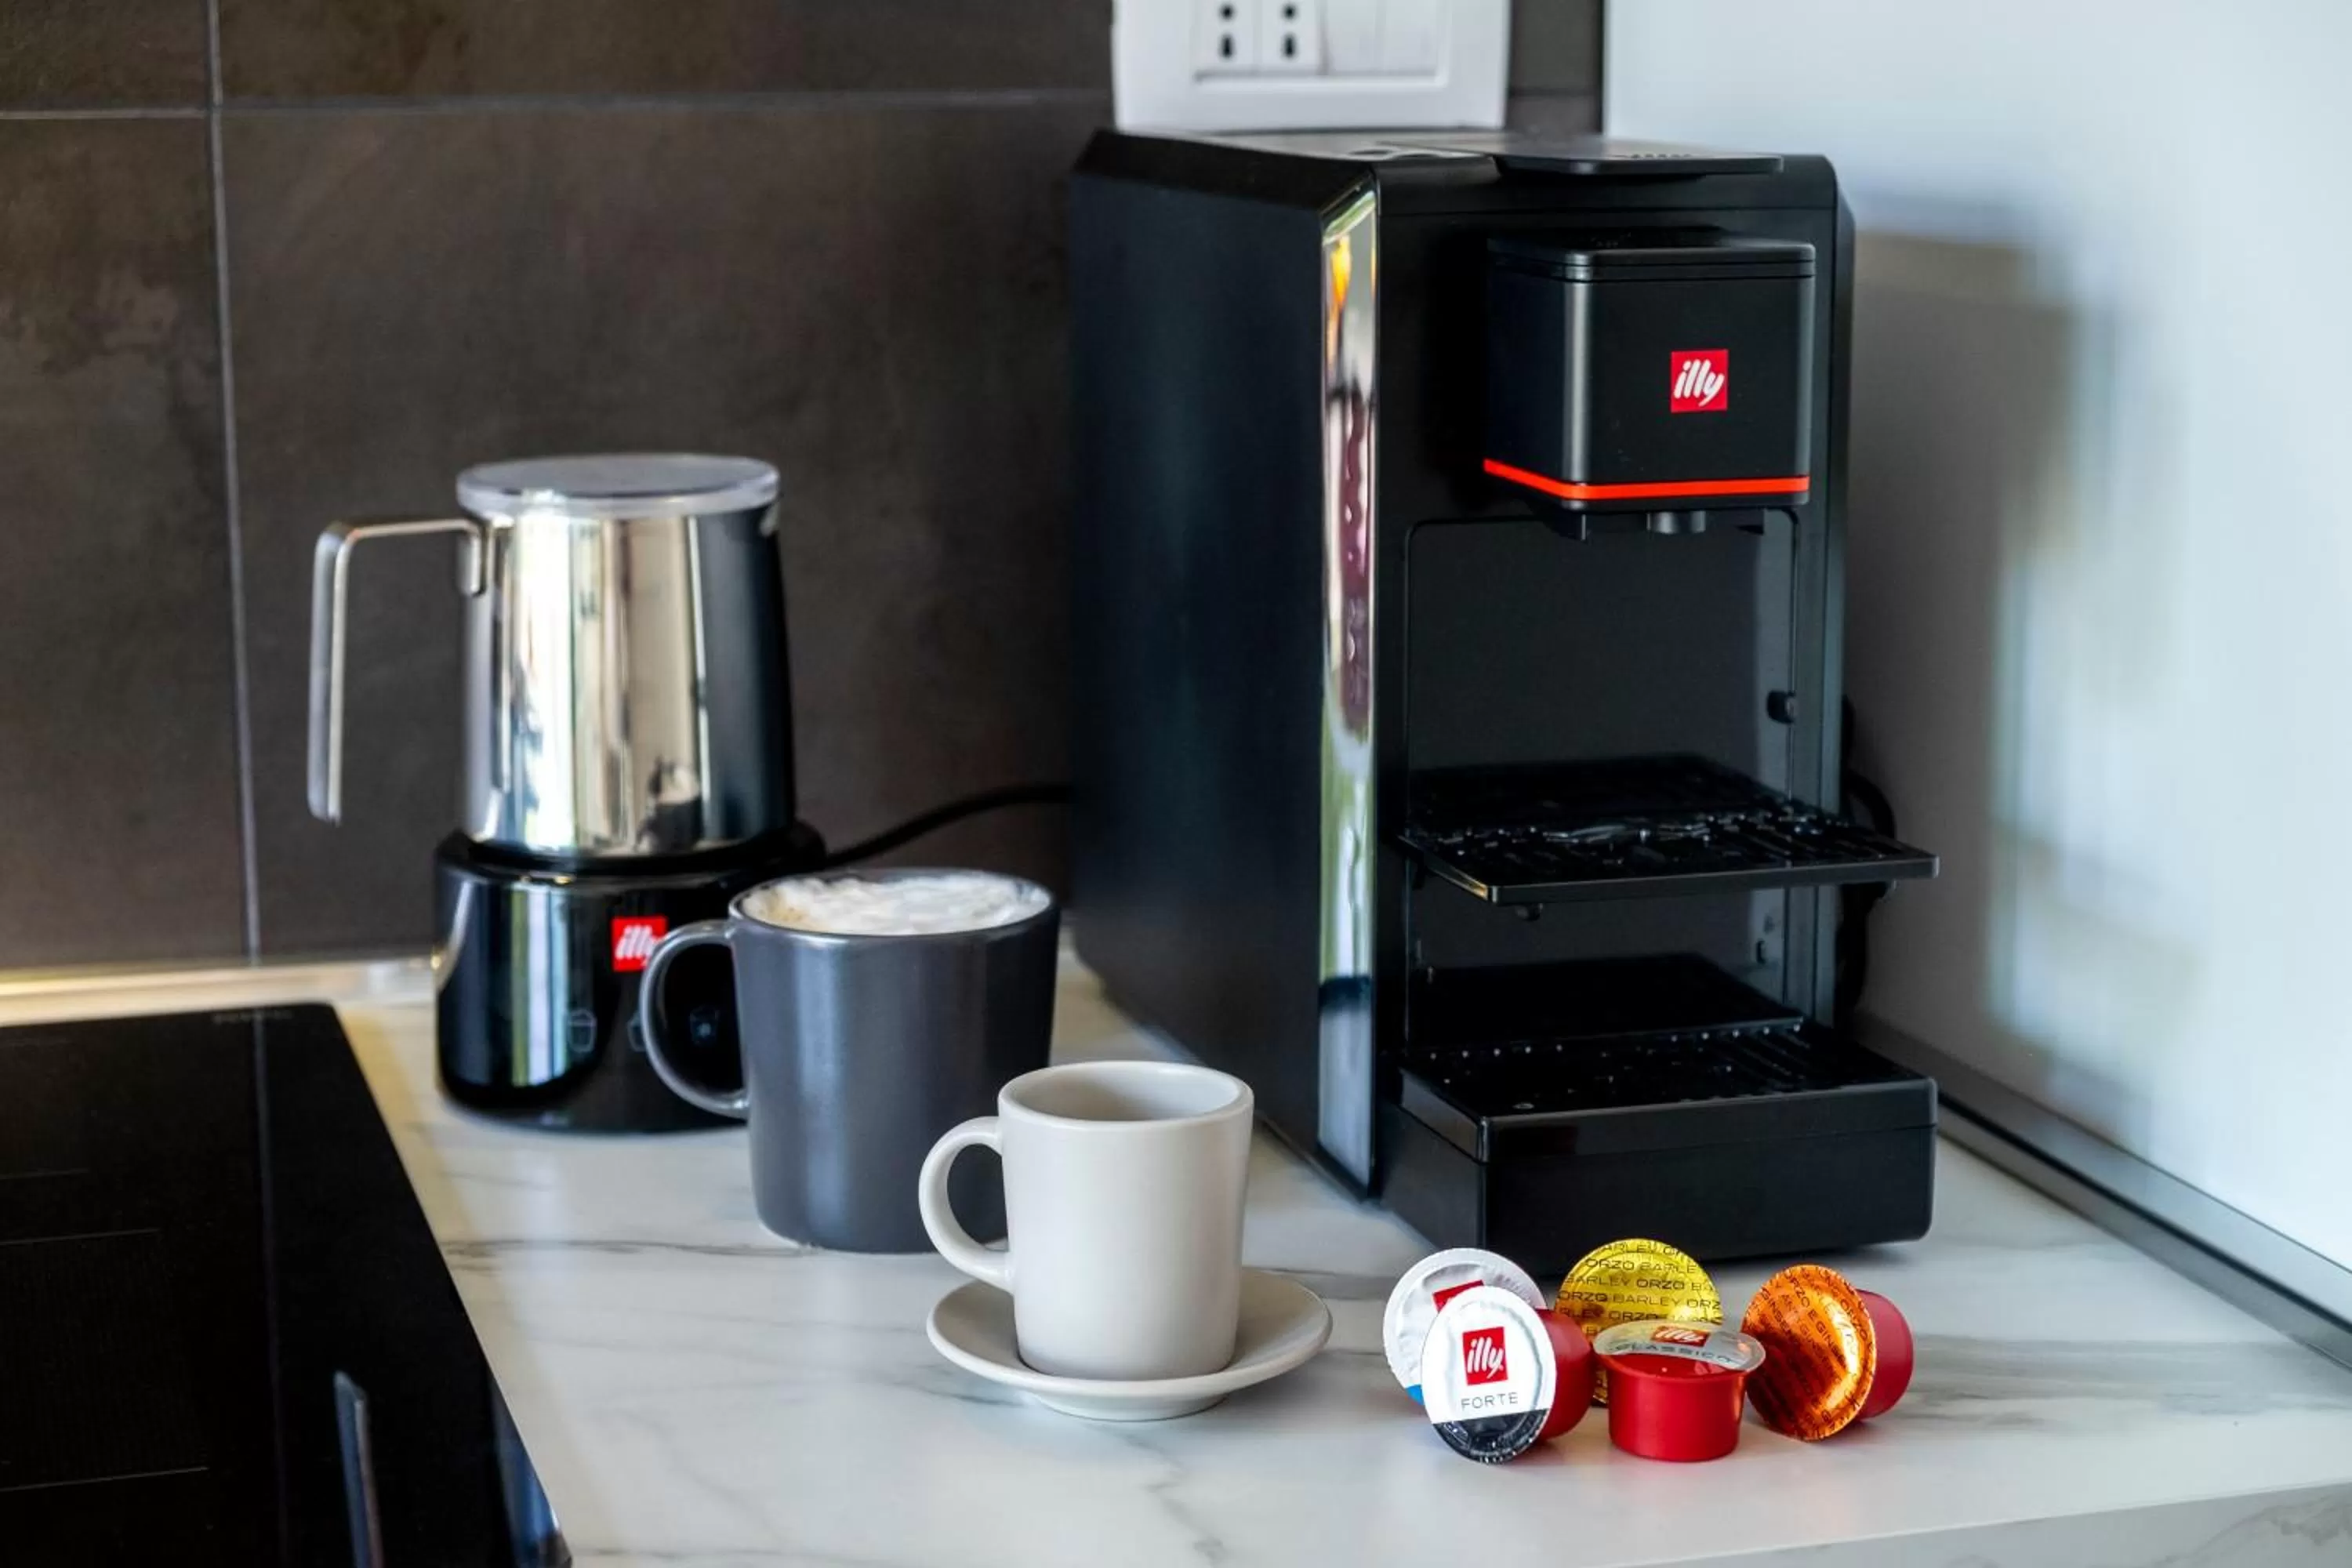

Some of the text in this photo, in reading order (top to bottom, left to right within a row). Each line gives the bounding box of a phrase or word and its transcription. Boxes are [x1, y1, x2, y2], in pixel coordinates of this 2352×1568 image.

[1674, 359, 1726, 407] illy
[1585, 1258, 1635, 1271] ORZO
[1636, 1278, 1685, 1290] ORZO
[1558, 1290, 1607, 1302] ORZO
[1613, 1294, 1681, 1307] BARLEY
[1467, 1336, 1504, 1378] illy
[1461, 1392, 1519, 1410] FORTE
